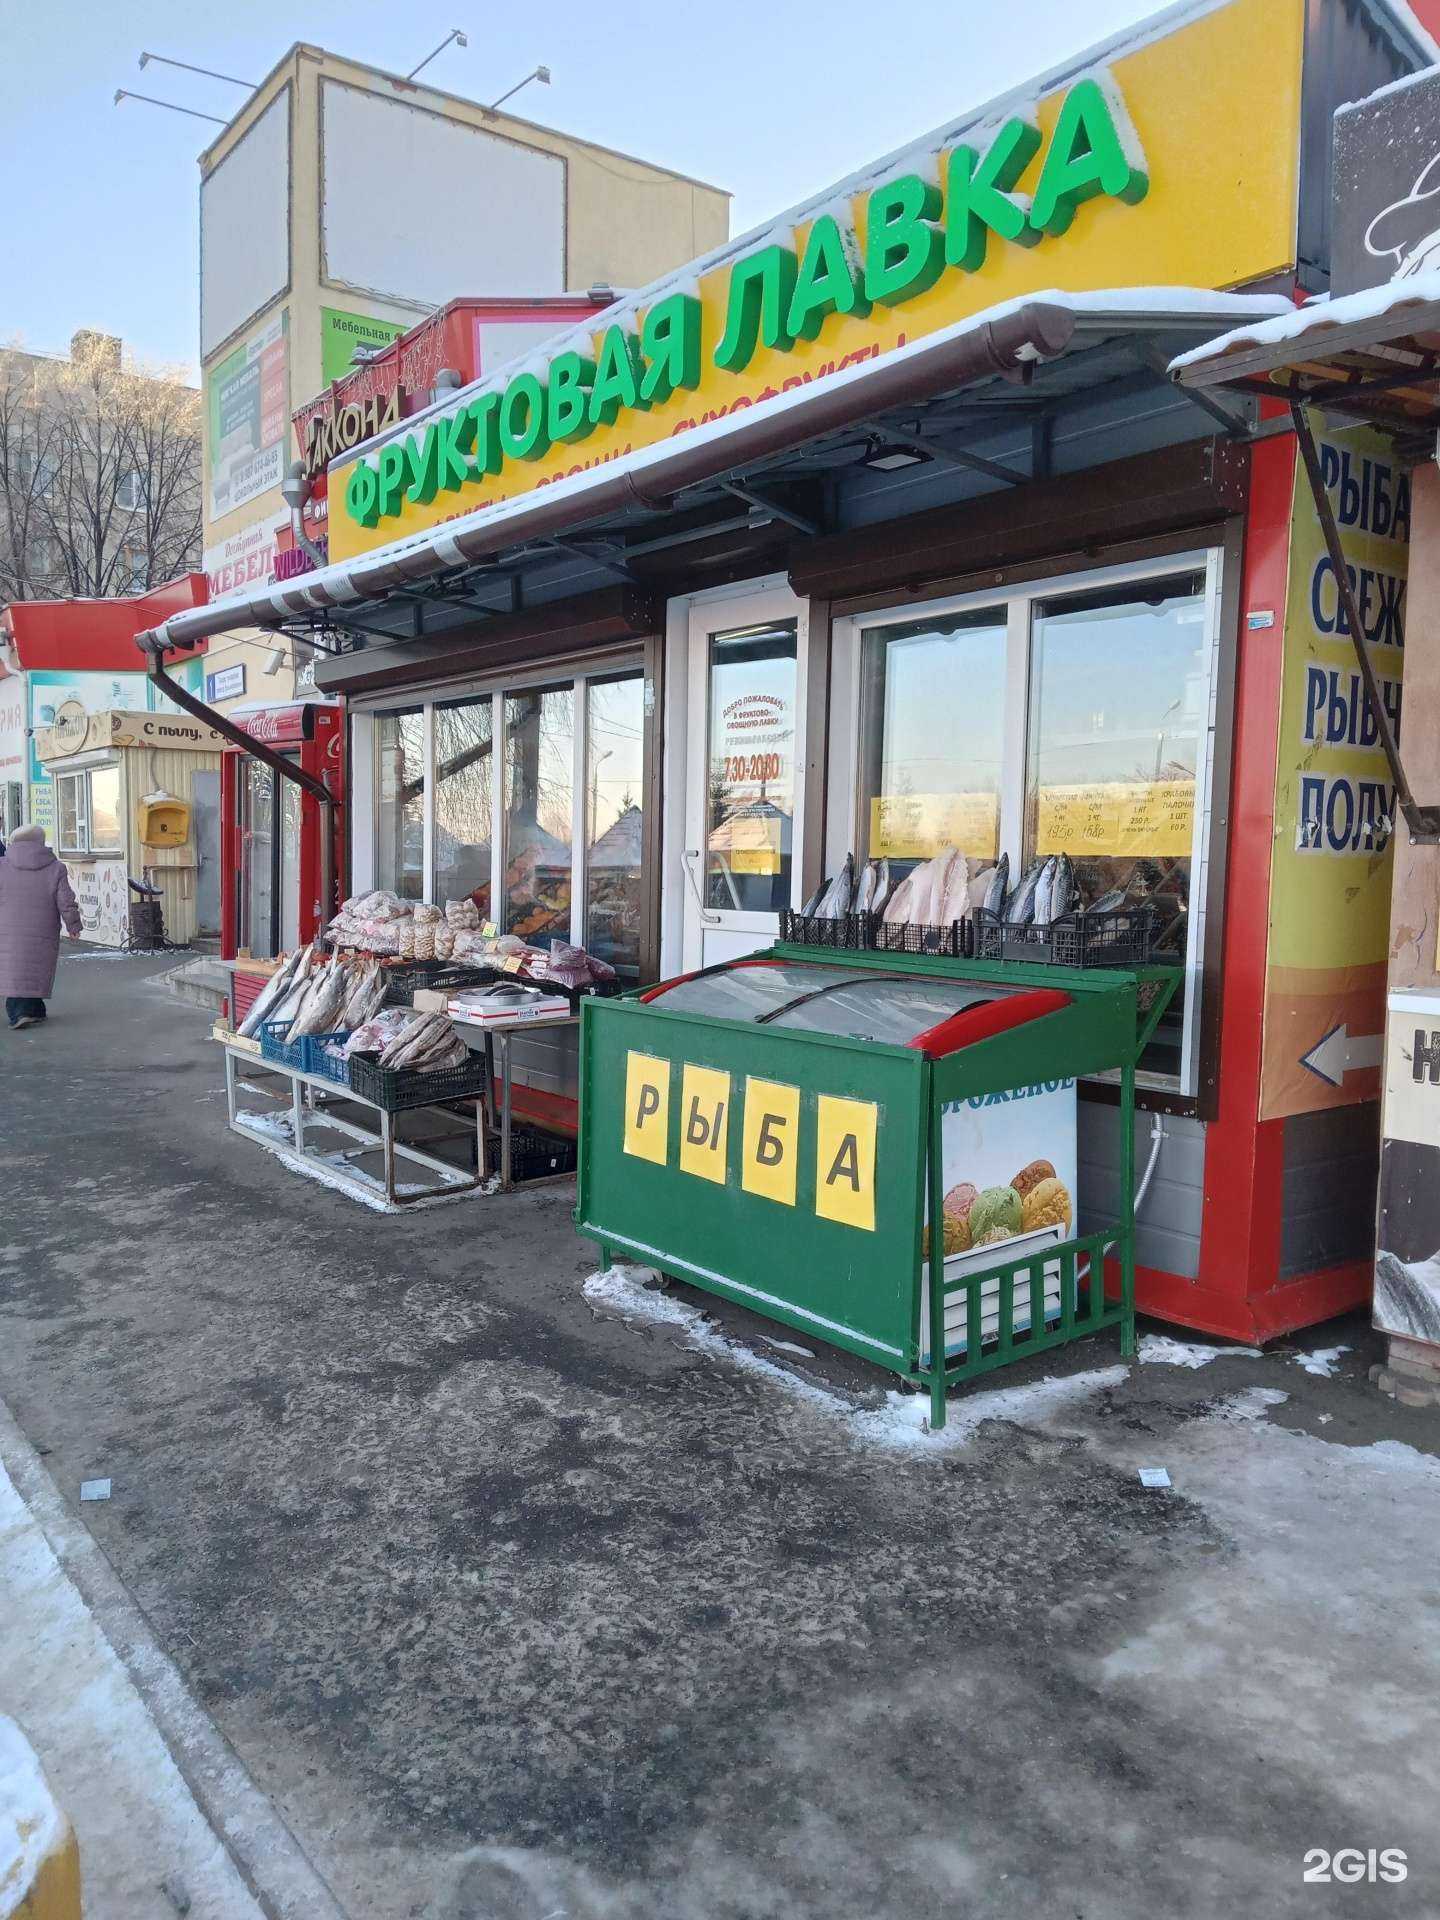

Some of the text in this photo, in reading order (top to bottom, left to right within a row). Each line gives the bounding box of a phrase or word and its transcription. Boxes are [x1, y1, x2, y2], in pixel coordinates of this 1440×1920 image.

[346, 78, 1148, 530] ФРУКТОВАЯ ЛАВКА
[332, 317, 391, 341] Мебельная
[158, 726, 202, 741] пылу,
